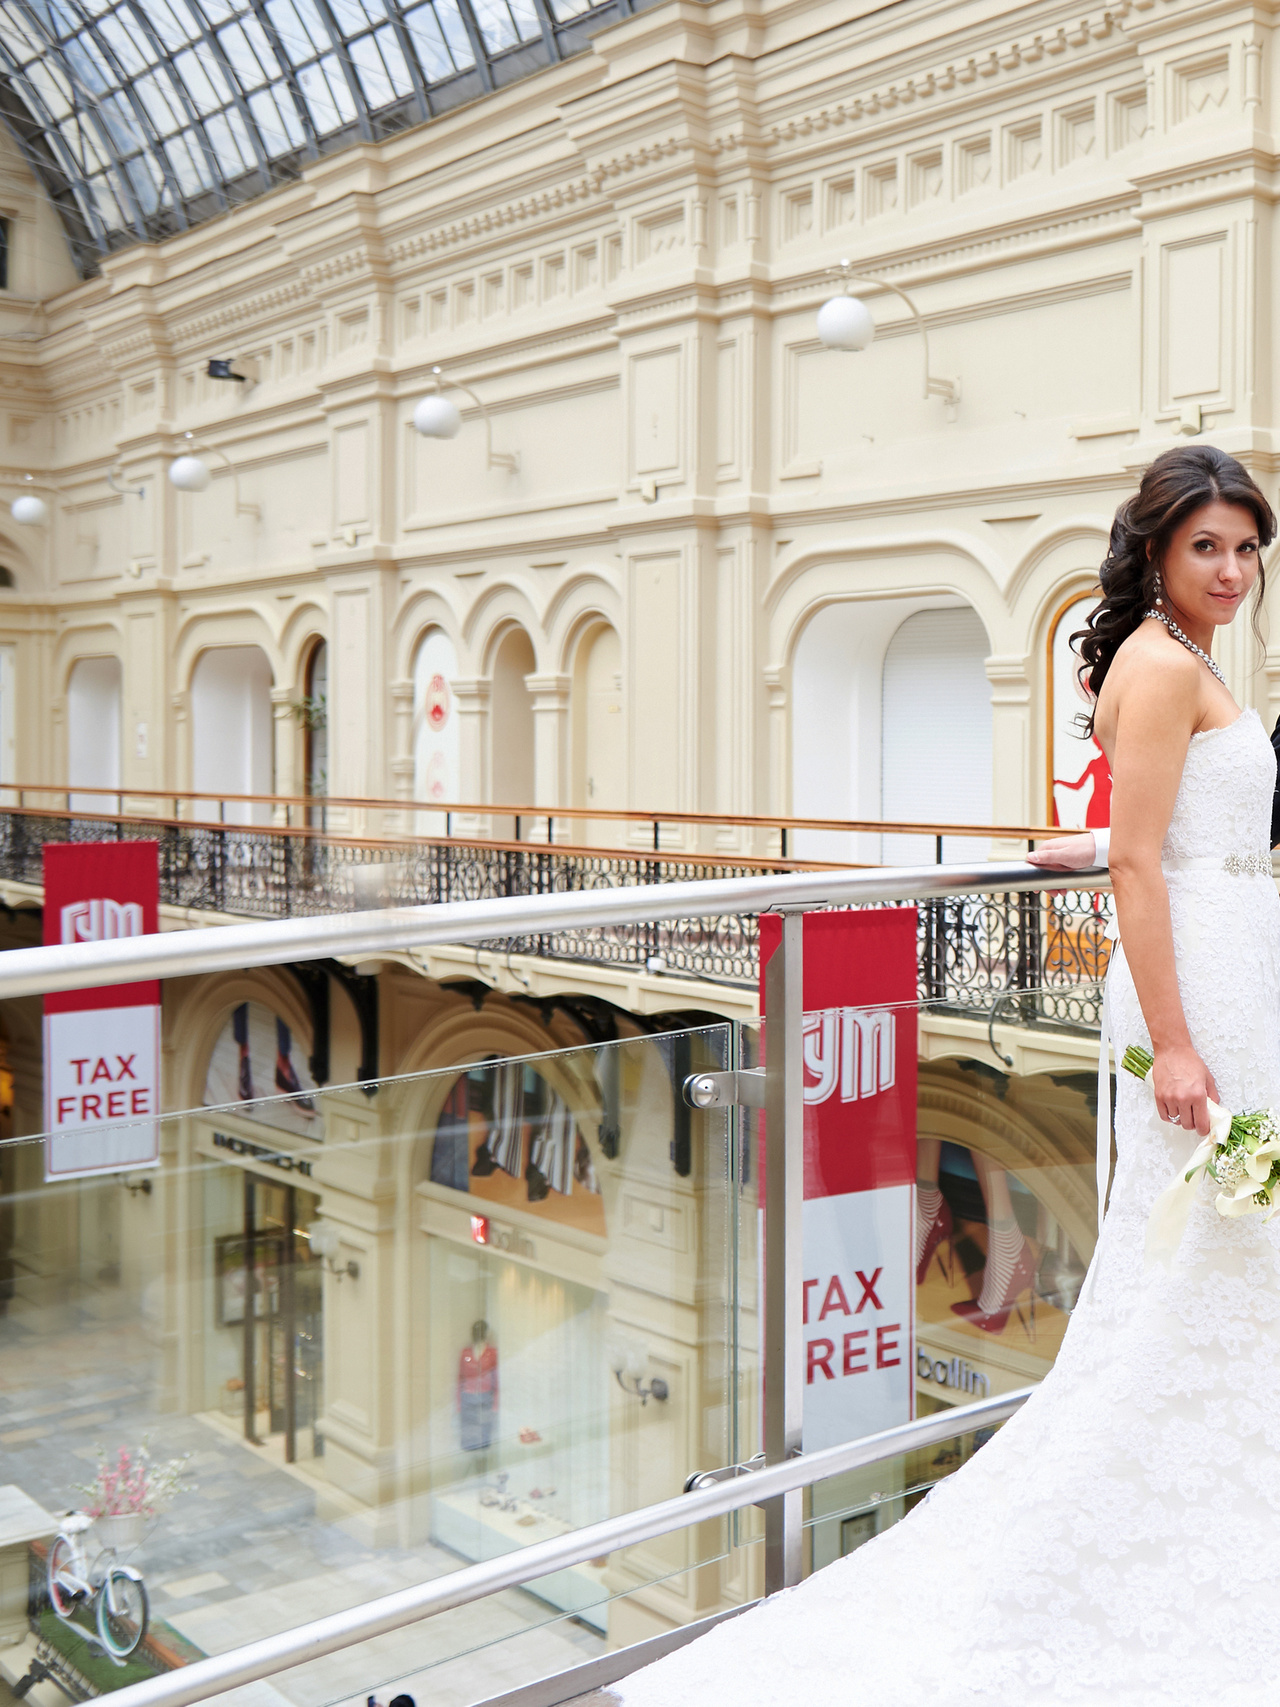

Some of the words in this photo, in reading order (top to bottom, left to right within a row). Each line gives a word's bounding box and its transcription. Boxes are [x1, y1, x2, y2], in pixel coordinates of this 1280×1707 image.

[70, 1054, 136, 1085] TAX
[58, 1089, 149, 1123] FREE
[807, 1323, 901, 1385] REE
[918, 1346, 990, 1399] ballin
